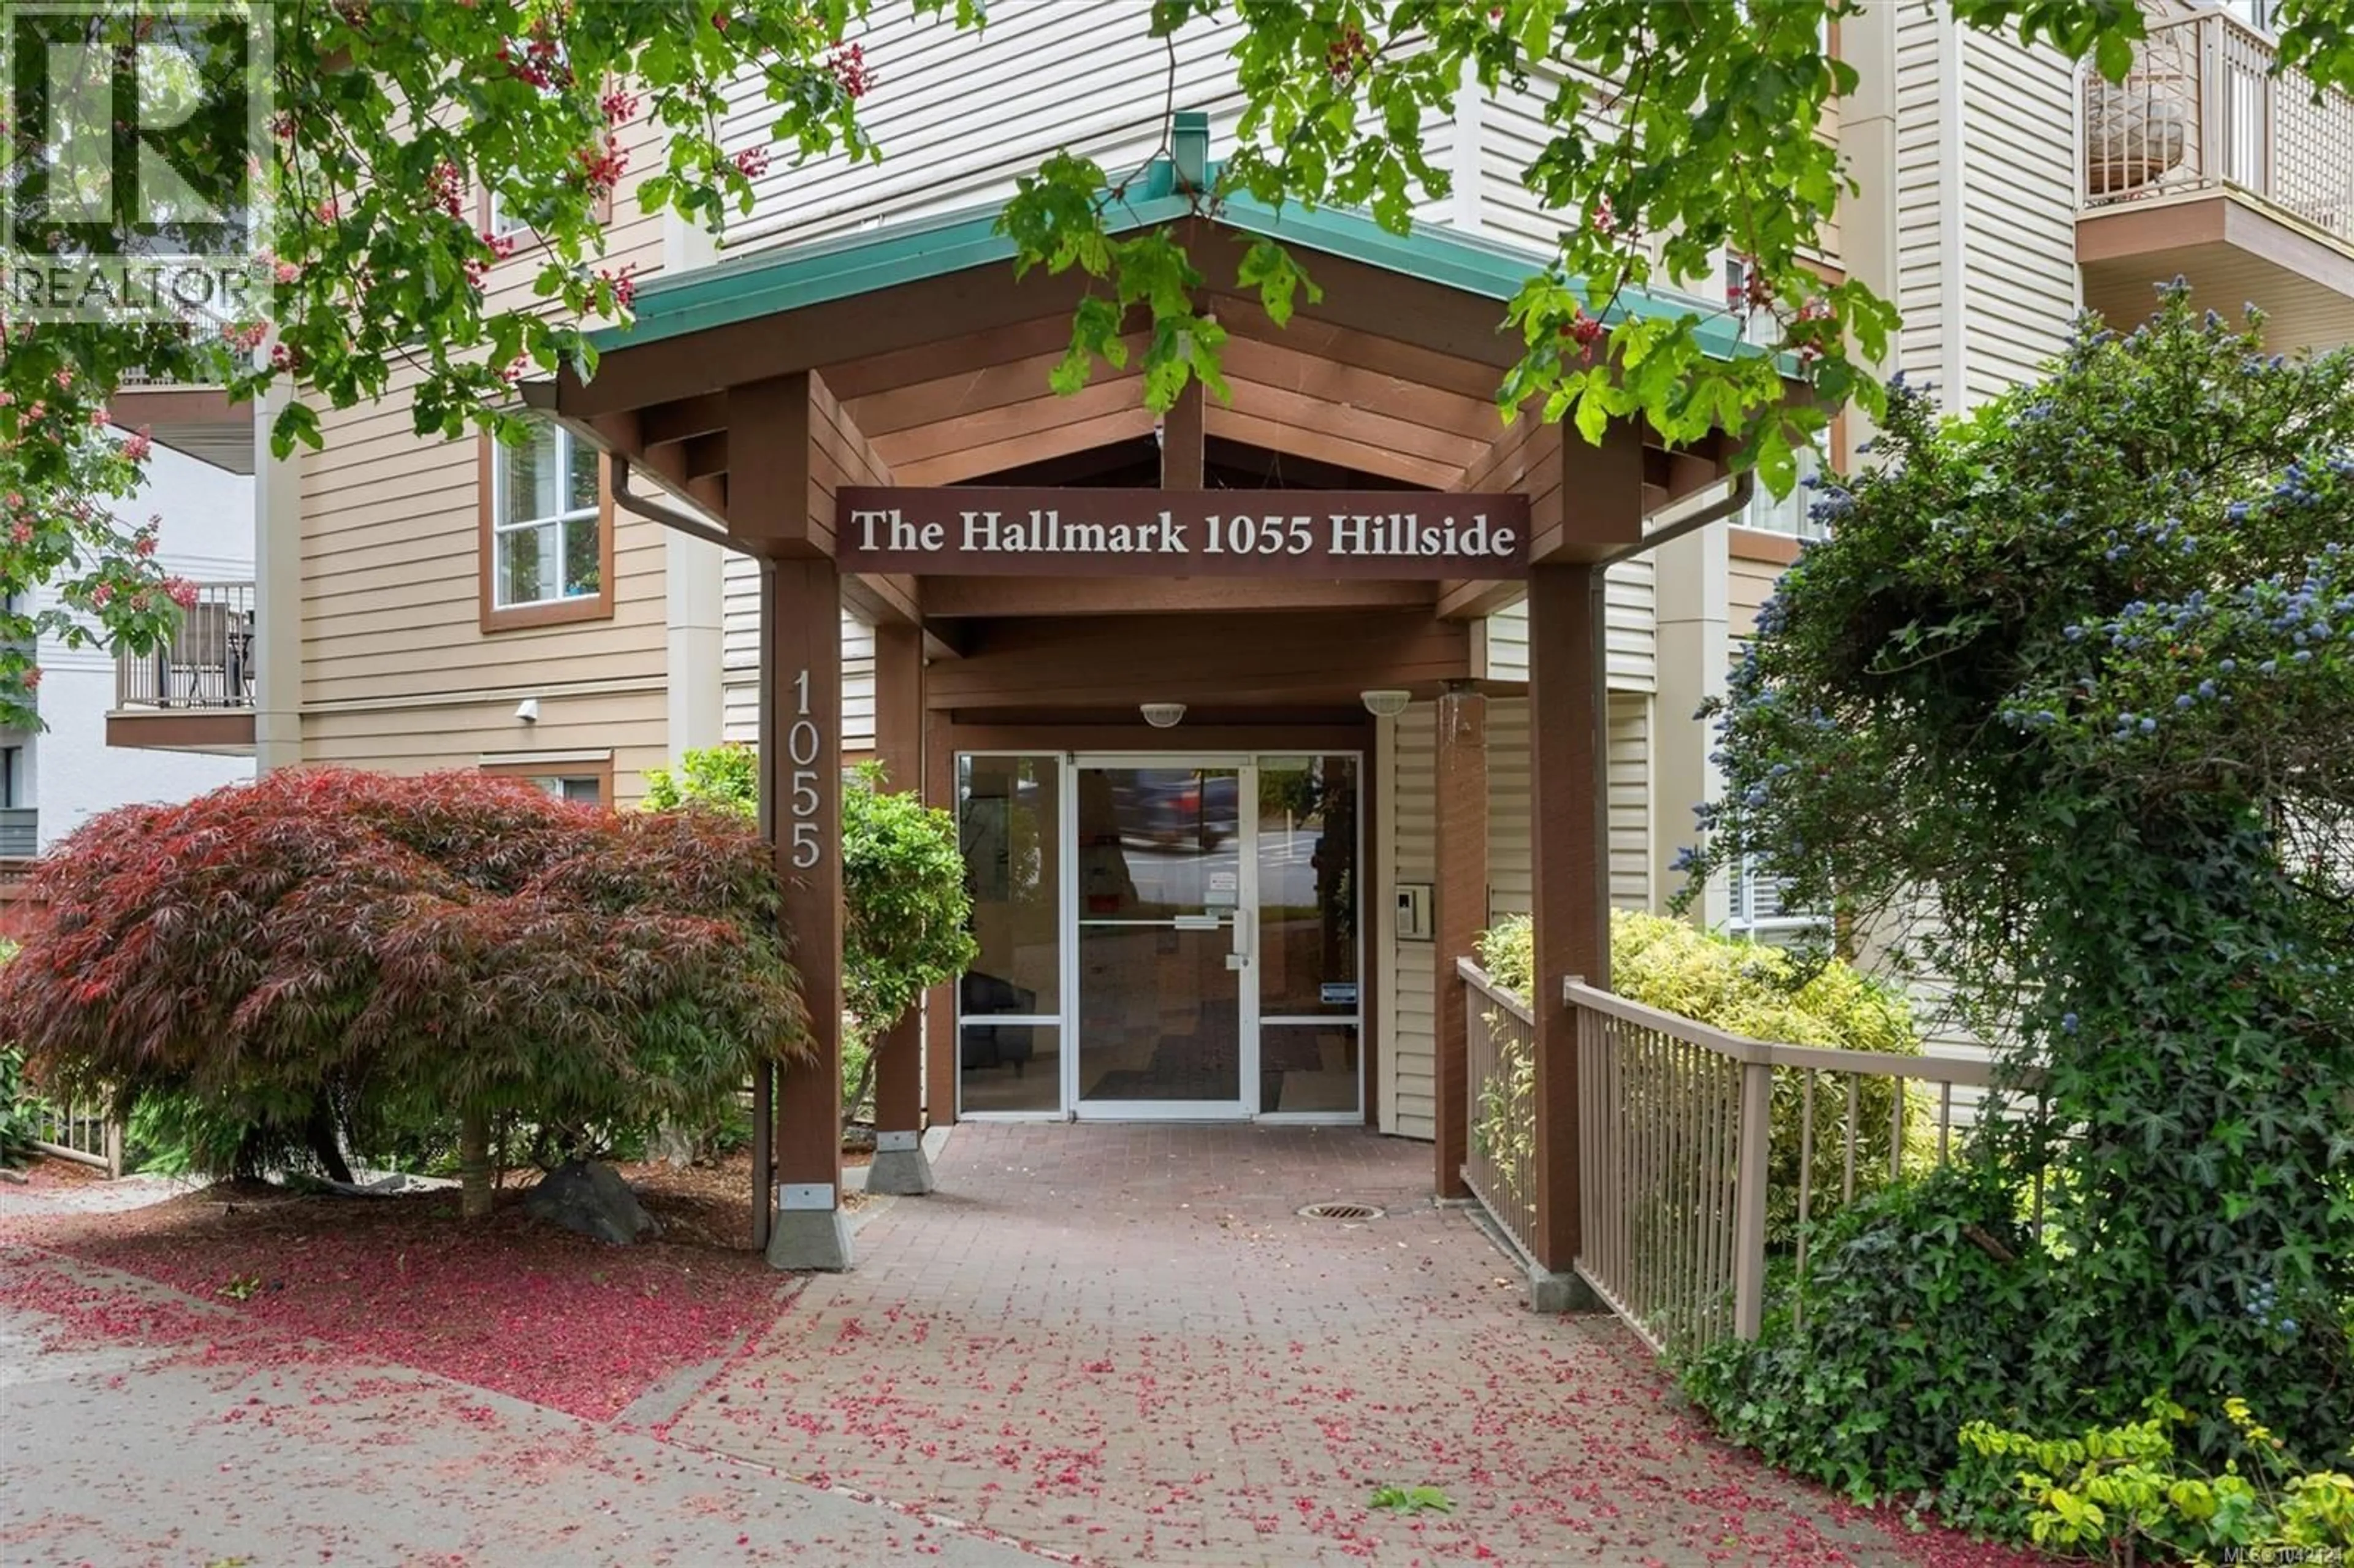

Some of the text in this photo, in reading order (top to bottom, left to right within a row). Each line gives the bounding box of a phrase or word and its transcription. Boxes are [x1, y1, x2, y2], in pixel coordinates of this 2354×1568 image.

[851, 509, 1516, 556] The Hallmark 1055 Hillside
[788, 669, 820, 868] 1055
